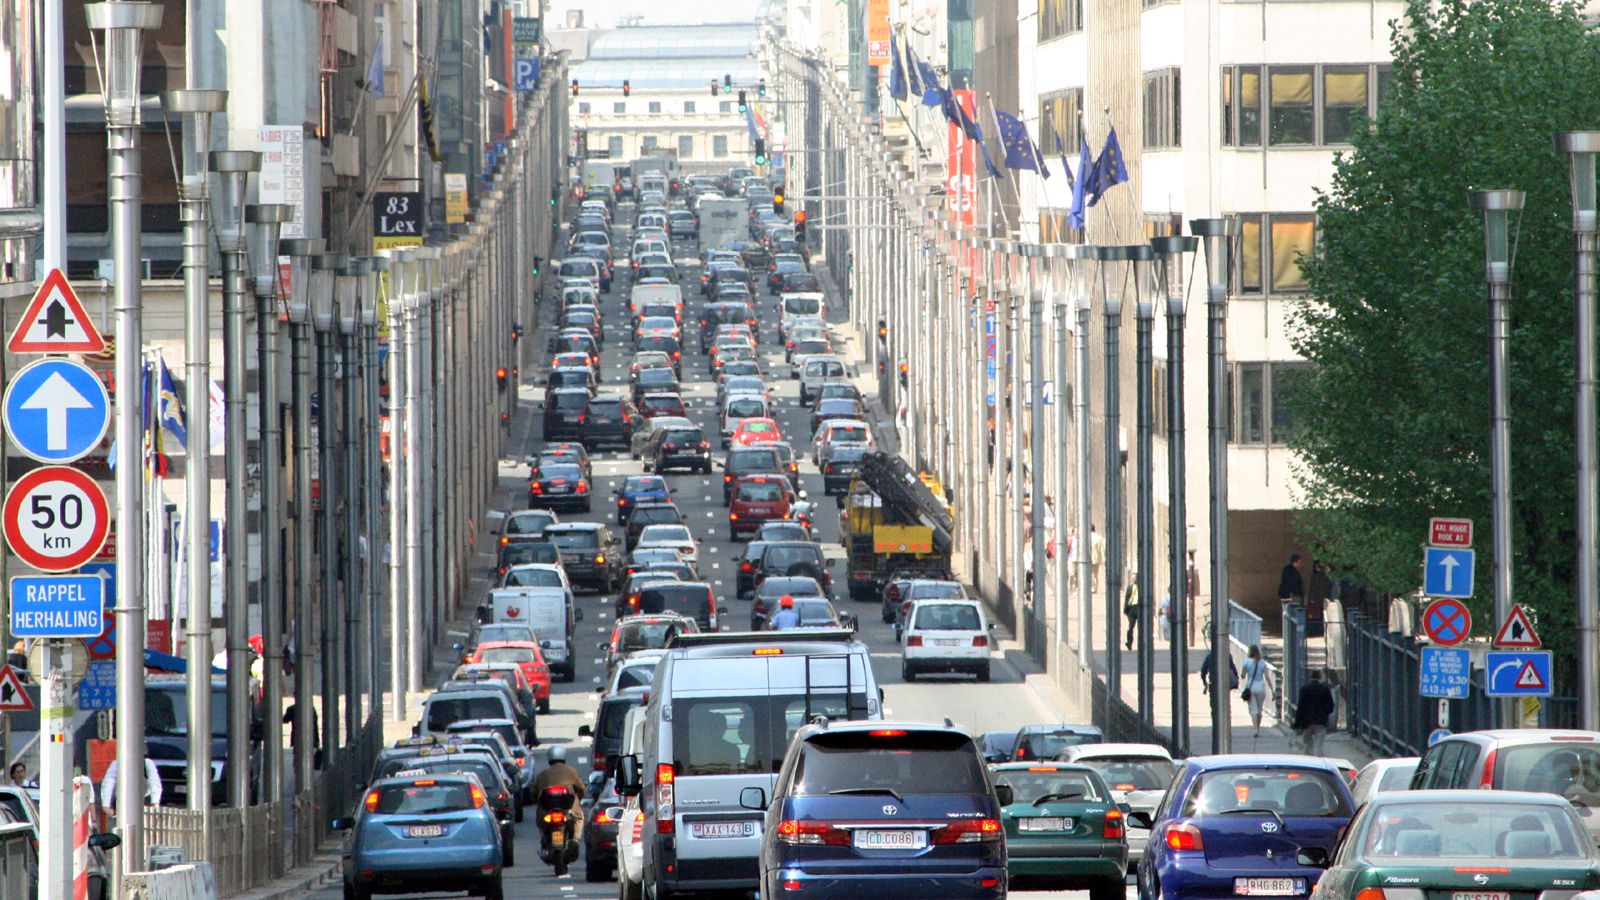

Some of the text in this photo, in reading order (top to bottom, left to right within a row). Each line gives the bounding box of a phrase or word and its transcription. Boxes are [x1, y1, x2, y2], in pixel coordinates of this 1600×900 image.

[517, 60, 532, 84] P
[386, 196, 409, 214] 83
[380, 216, 416, 233] Lex
[31, 494, 82, 529] 50
[43, 532, 71, 549] km
[26, 584, 86, 602] RAPPEL
[15, 611, 98, 628] HERHALING
[1432, 674, 1438, 684] 7
